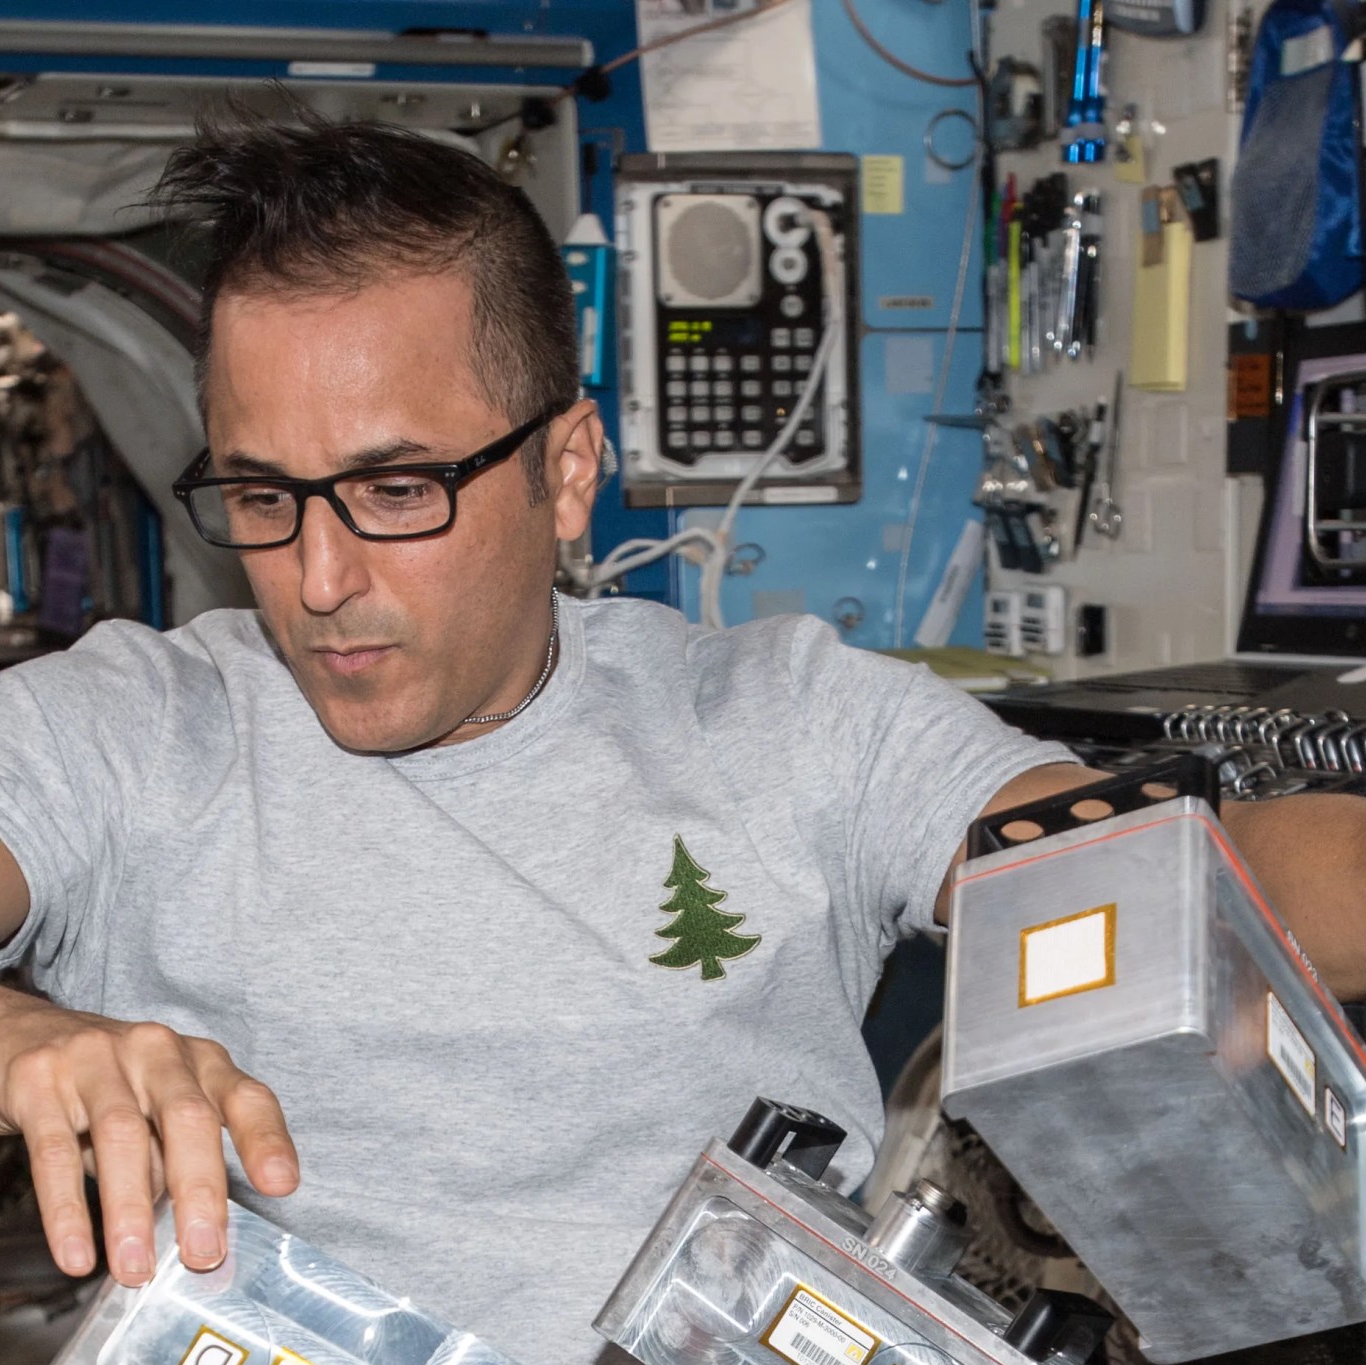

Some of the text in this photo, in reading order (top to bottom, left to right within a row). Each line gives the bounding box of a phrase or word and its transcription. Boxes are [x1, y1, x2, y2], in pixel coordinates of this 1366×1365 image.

[1330, 1098, 1343, 1138] E
[842, 1237, 897, 1281] SN 024
[798, 1293, 843, 1327] BRIC Canister
